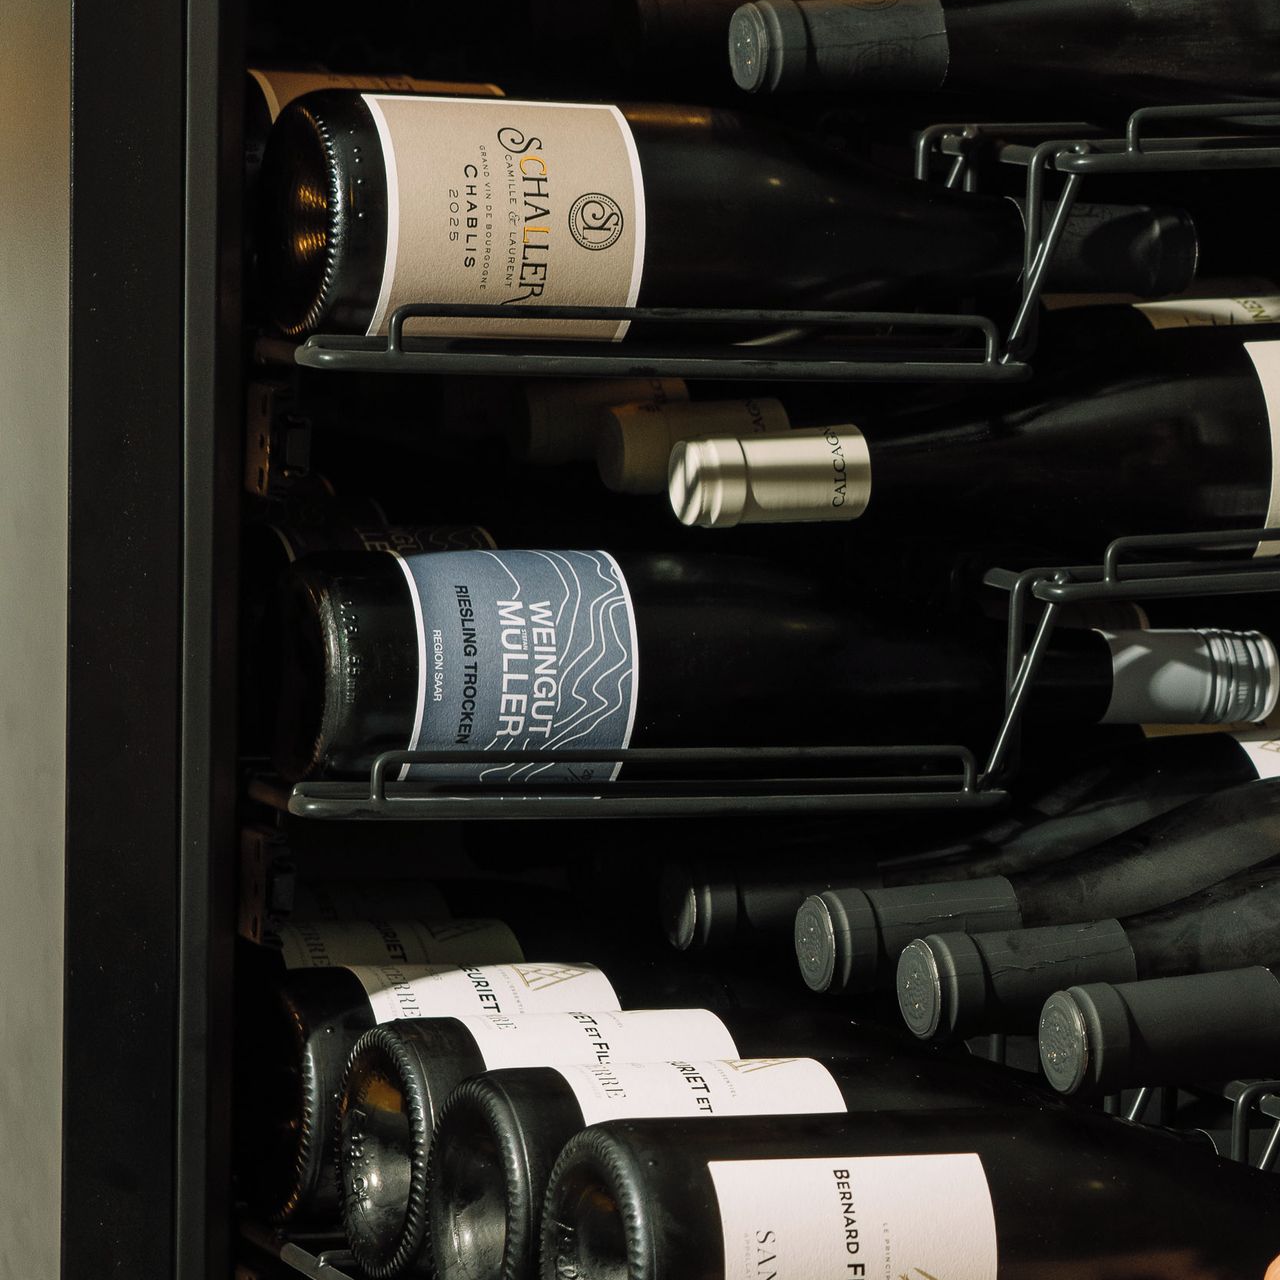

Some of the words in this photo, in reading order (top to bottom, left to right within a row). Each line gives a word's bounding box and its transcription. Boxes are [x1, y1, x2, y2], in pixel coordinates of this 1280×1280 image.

[479, 145, 490, 178] GRAND
[504, 154, 517, 205] CAMILLE
[448, 189, 459, 241] 2025
[464, 164, 478, 268] CHABLIS
[486, 206, 492, 216] DE
[497, 127, 549, 305] SCHALLER
[479, 224, 492, 290] BOURGOGNE
[504, 232, 516, 288] LAURENT
[454, 585, 477, 658] RIESLING
[520, 628, 528, 651] STEFAN
[433, 629, 443, 670] REGION
[528, 601, 557, 738] WEINGUT
[433, 672, 443, 702] SAAR
[455, 662, 478, 745] TROCKEN
[696, 1096, 714, 1113] ET
[833, 1169, 860, 1254] BERNARD
